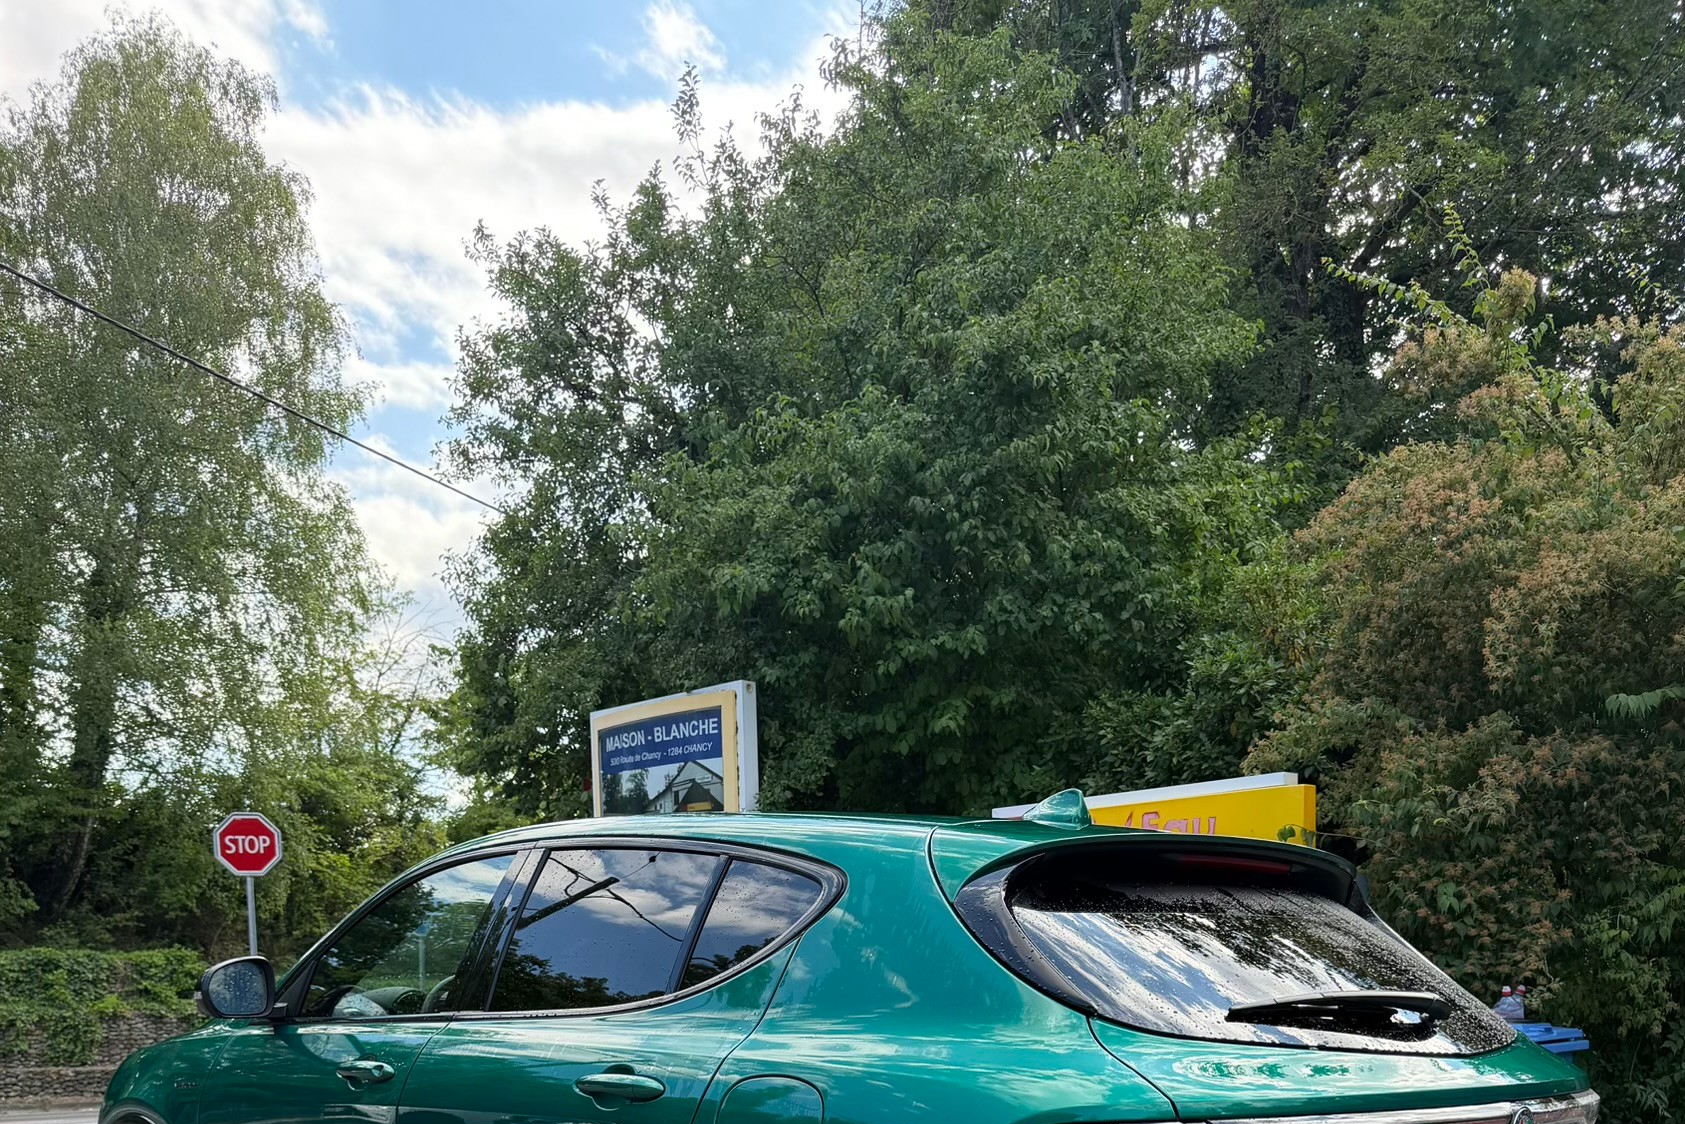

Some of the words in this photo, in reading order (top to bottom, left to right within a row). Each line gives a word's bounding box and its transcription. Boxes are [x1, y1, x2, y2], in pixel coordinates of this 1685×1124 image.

[606, 730, 645, 752] MAISON
[654, 718, 718, 742] BLANCHE
[641, 751, 662, 760] Chancy
[667, 746, 683, 756] 1284
[683, 742, 713, 754] CHANCY
[224, 835, 271, 855] STOP
